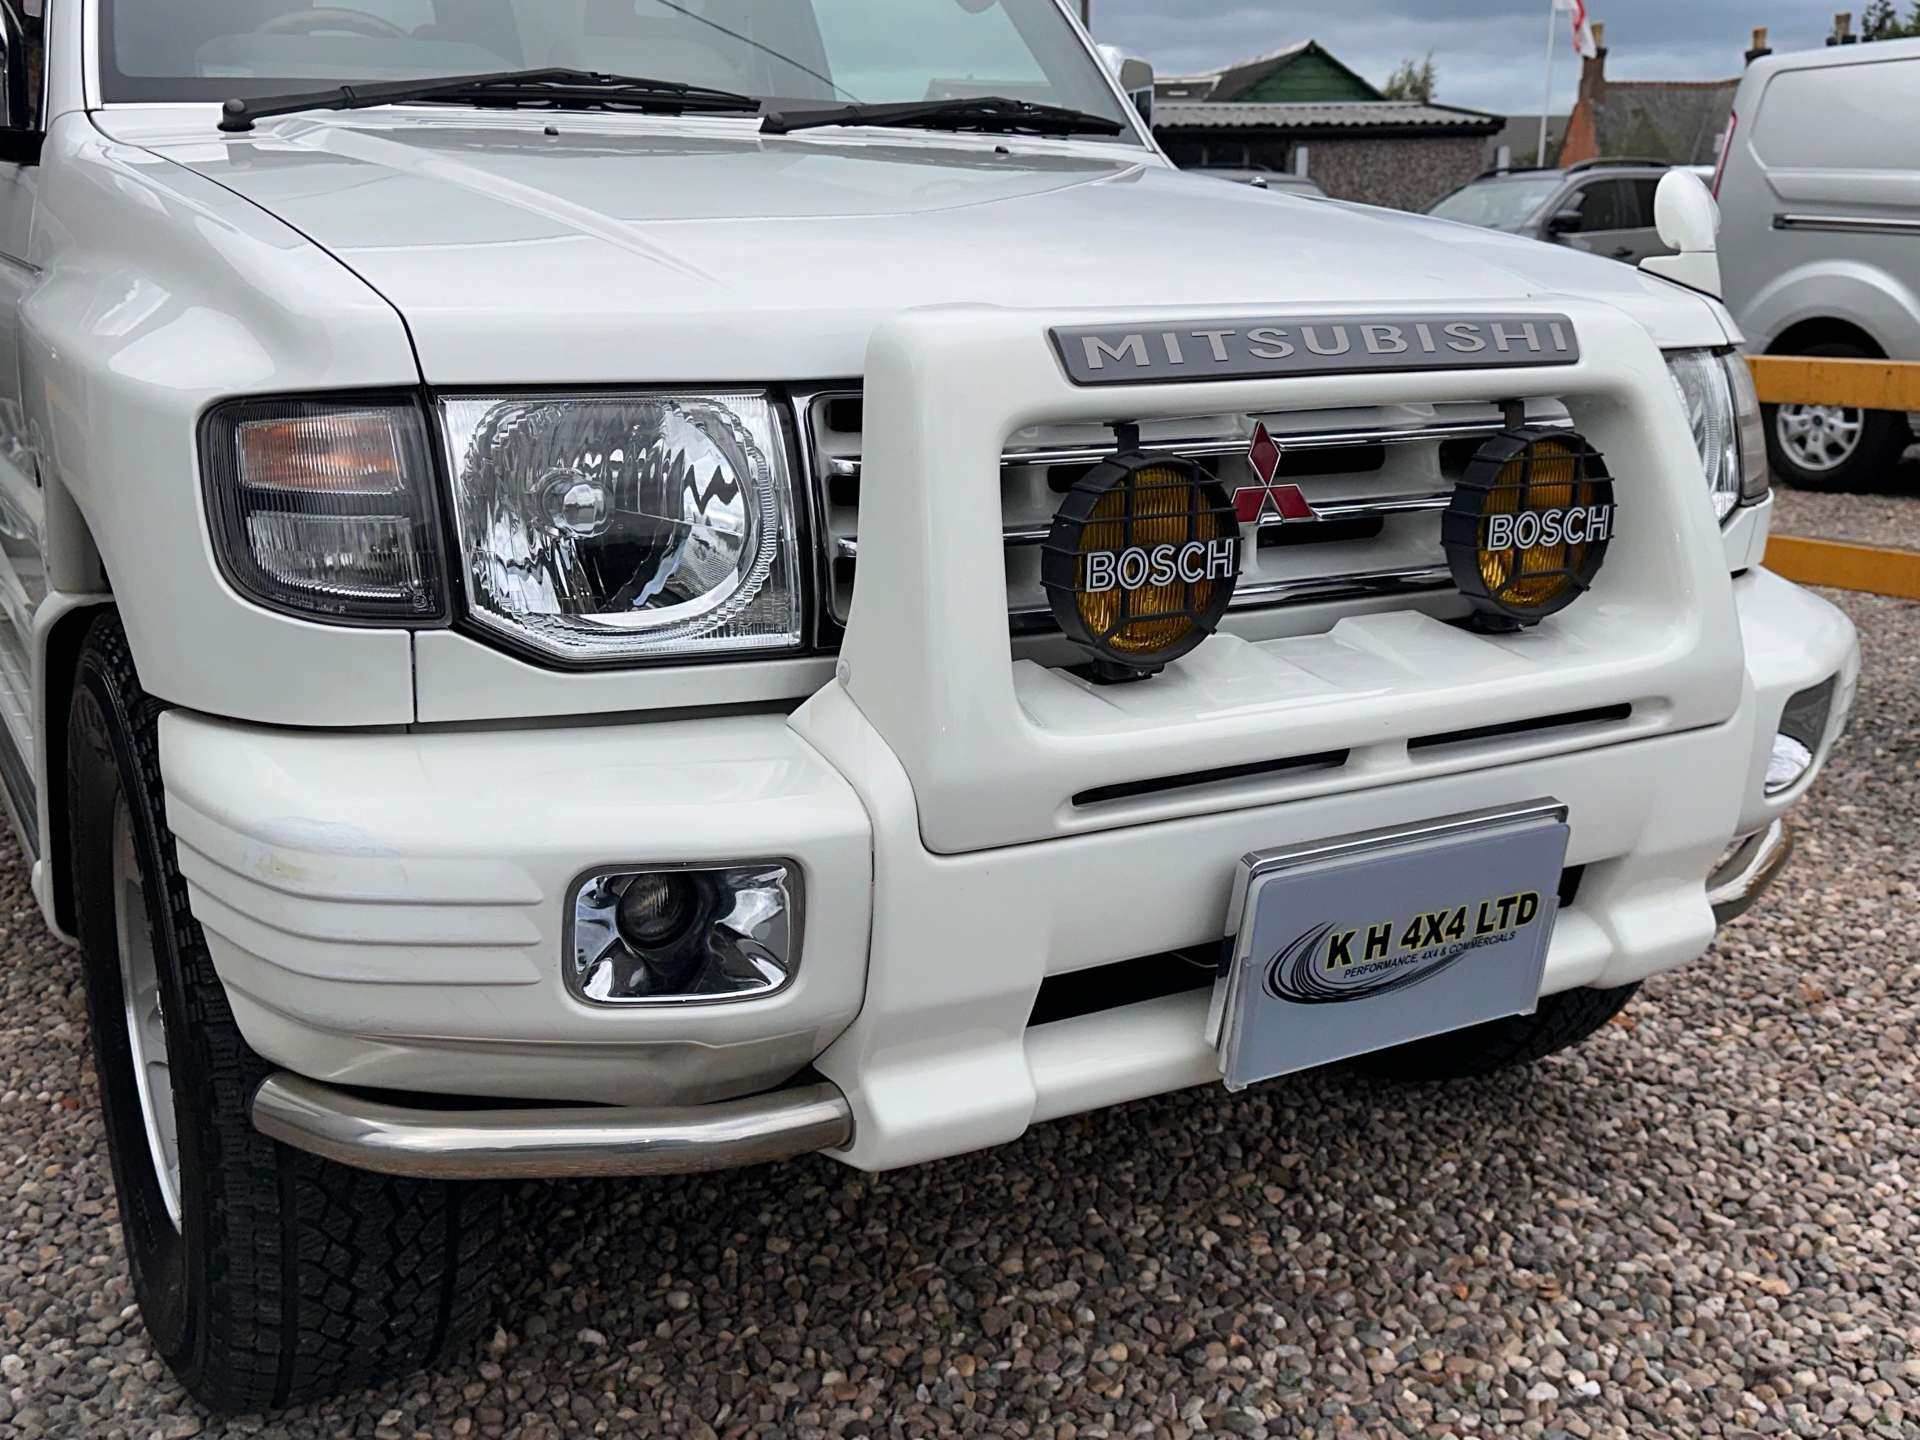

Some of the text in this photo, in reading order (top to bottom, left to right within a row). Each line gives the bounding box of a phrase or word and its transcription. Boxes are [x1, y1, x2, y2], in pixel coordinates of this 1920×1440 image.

[1081, 322, 1568, 369] MITSUBISHI
[1487, 505, 1610, 551] BOSCH
[1086, 538, 1234, 592] BOSCH
[1325, 891, 1540, 971] K H 4X4 LTD
